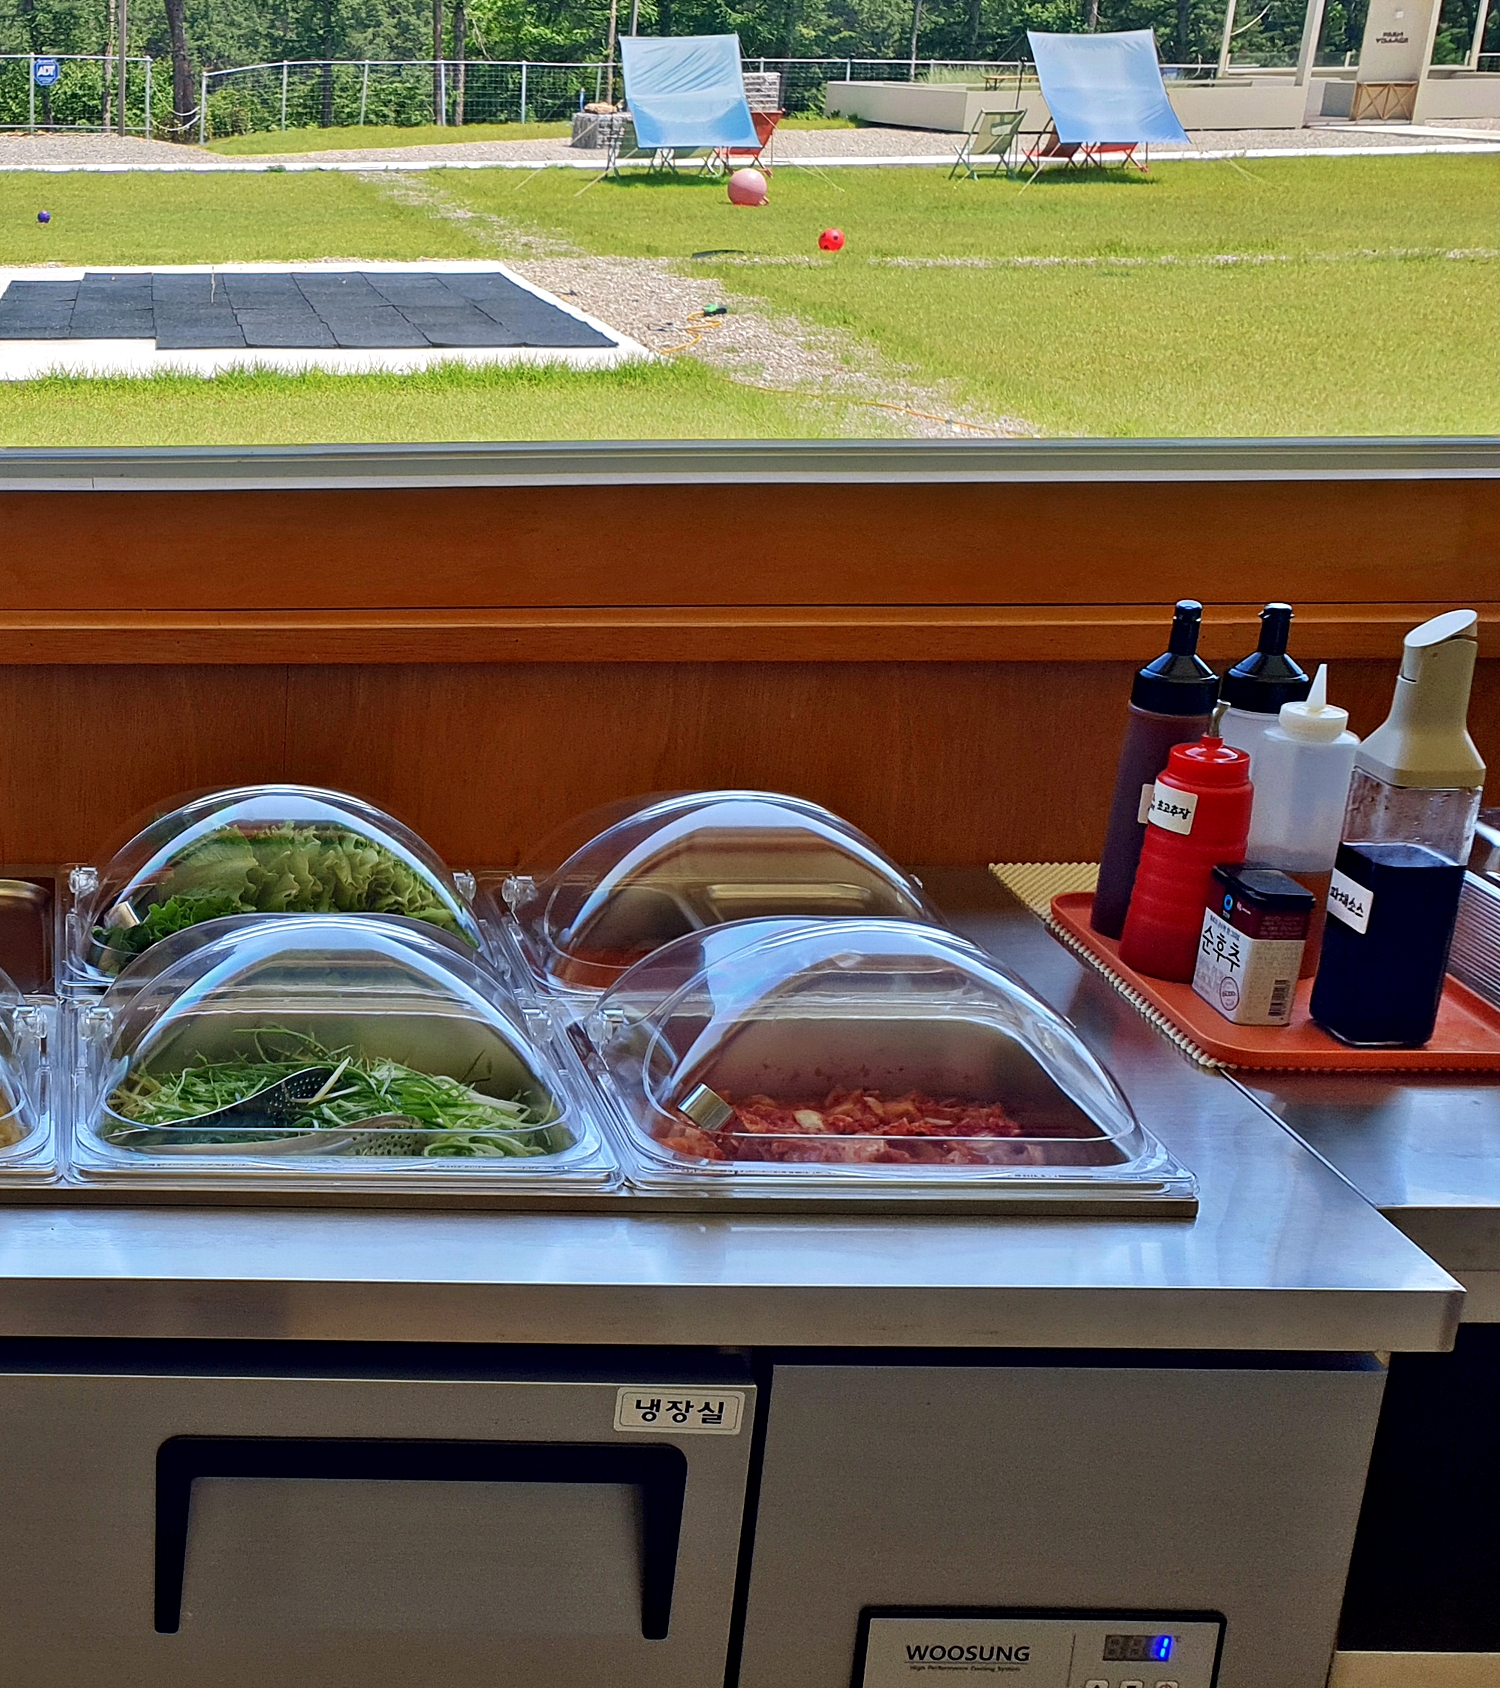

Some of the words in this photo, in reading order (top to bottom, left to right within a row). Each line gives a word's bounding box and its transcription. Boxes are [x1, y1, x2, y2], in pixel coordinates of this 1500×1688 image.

[37, 65, 55, 76] ADT
[1156, 799, 1192, 820] 초고추장
[1329, 886, 1364, 918] 파채소스
[1202, 925, 1241, 972] 순후추
[635, 1398, 725, 1425] 냉장실
[906, 1644, 1031, 1662] WOOSUNG
[1159, 1638, 1169, 1658] 1
